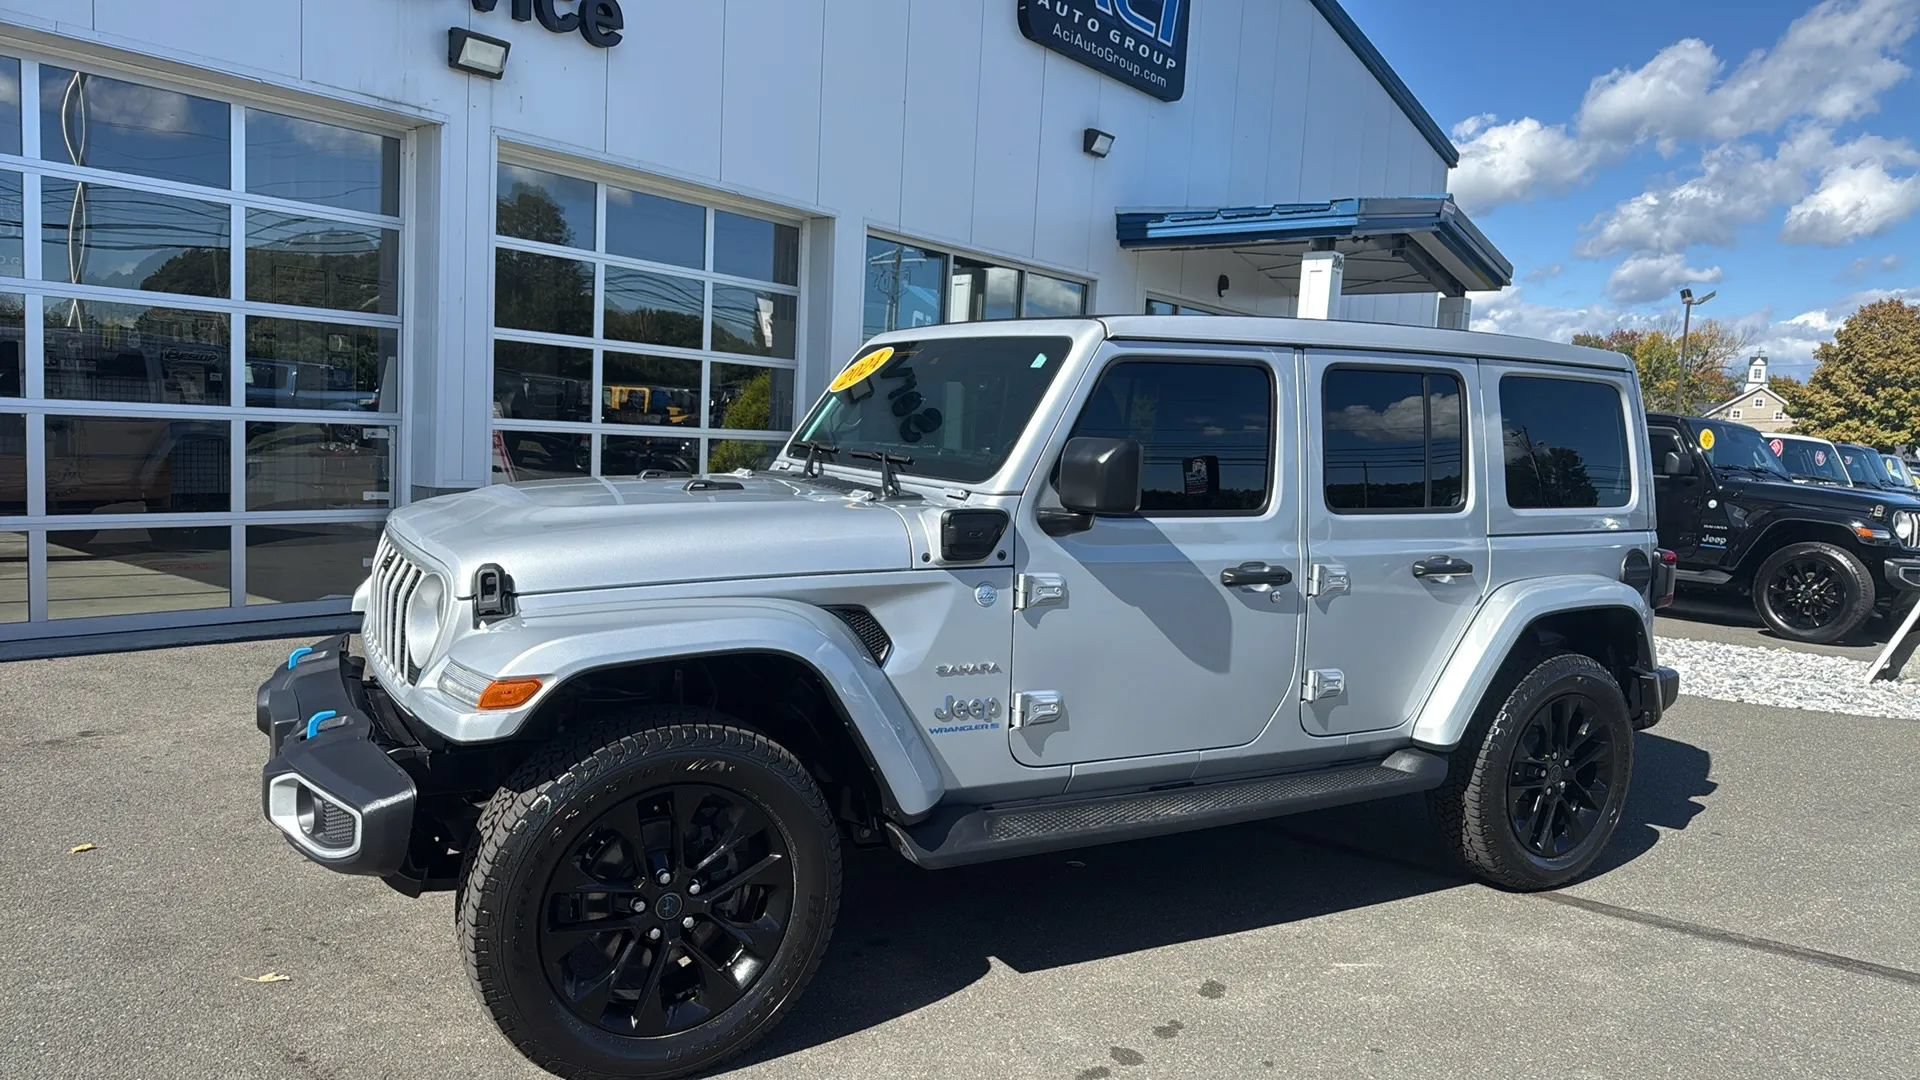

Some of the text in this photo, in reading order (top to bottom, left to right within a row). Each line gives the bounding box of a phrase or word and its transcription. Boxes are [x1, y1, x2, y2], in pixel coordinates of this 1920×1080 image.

[1037, 0, 1177, 70] AUTO GROUP
[1052, 23, 1168, 88] AciAutoGroup.com
[1702, 534, 1727, 545] Jeep
[936, 662, 1002, 677] SAHARA
[934, 695, 1001, 722] Jeep
[929, 724, 989, 734] WRANGLER
